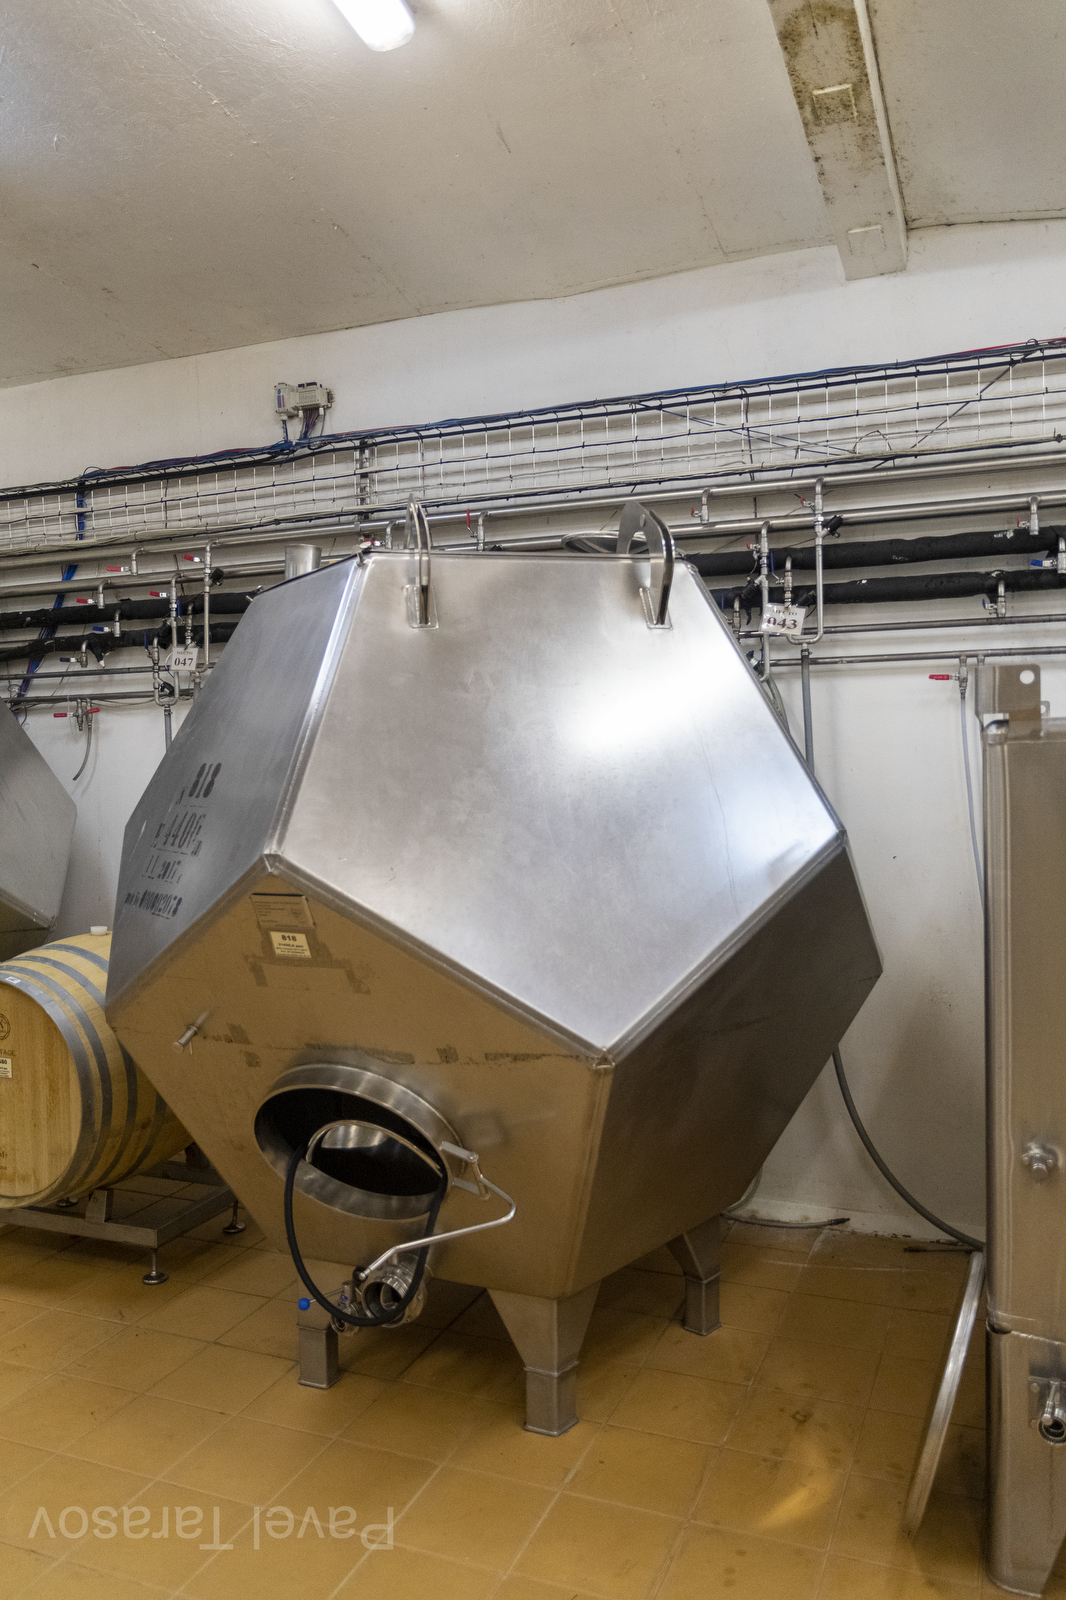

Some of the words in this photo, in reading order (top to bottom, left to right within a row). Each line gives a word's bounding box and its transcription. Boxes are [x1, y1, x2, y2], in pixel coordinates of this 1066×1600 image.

[767, 617, 797, 629] 043
[174, 657, 194, 667] 047
[188, 762, 222, 799] 818
[281, 934, 298, 942] 818
